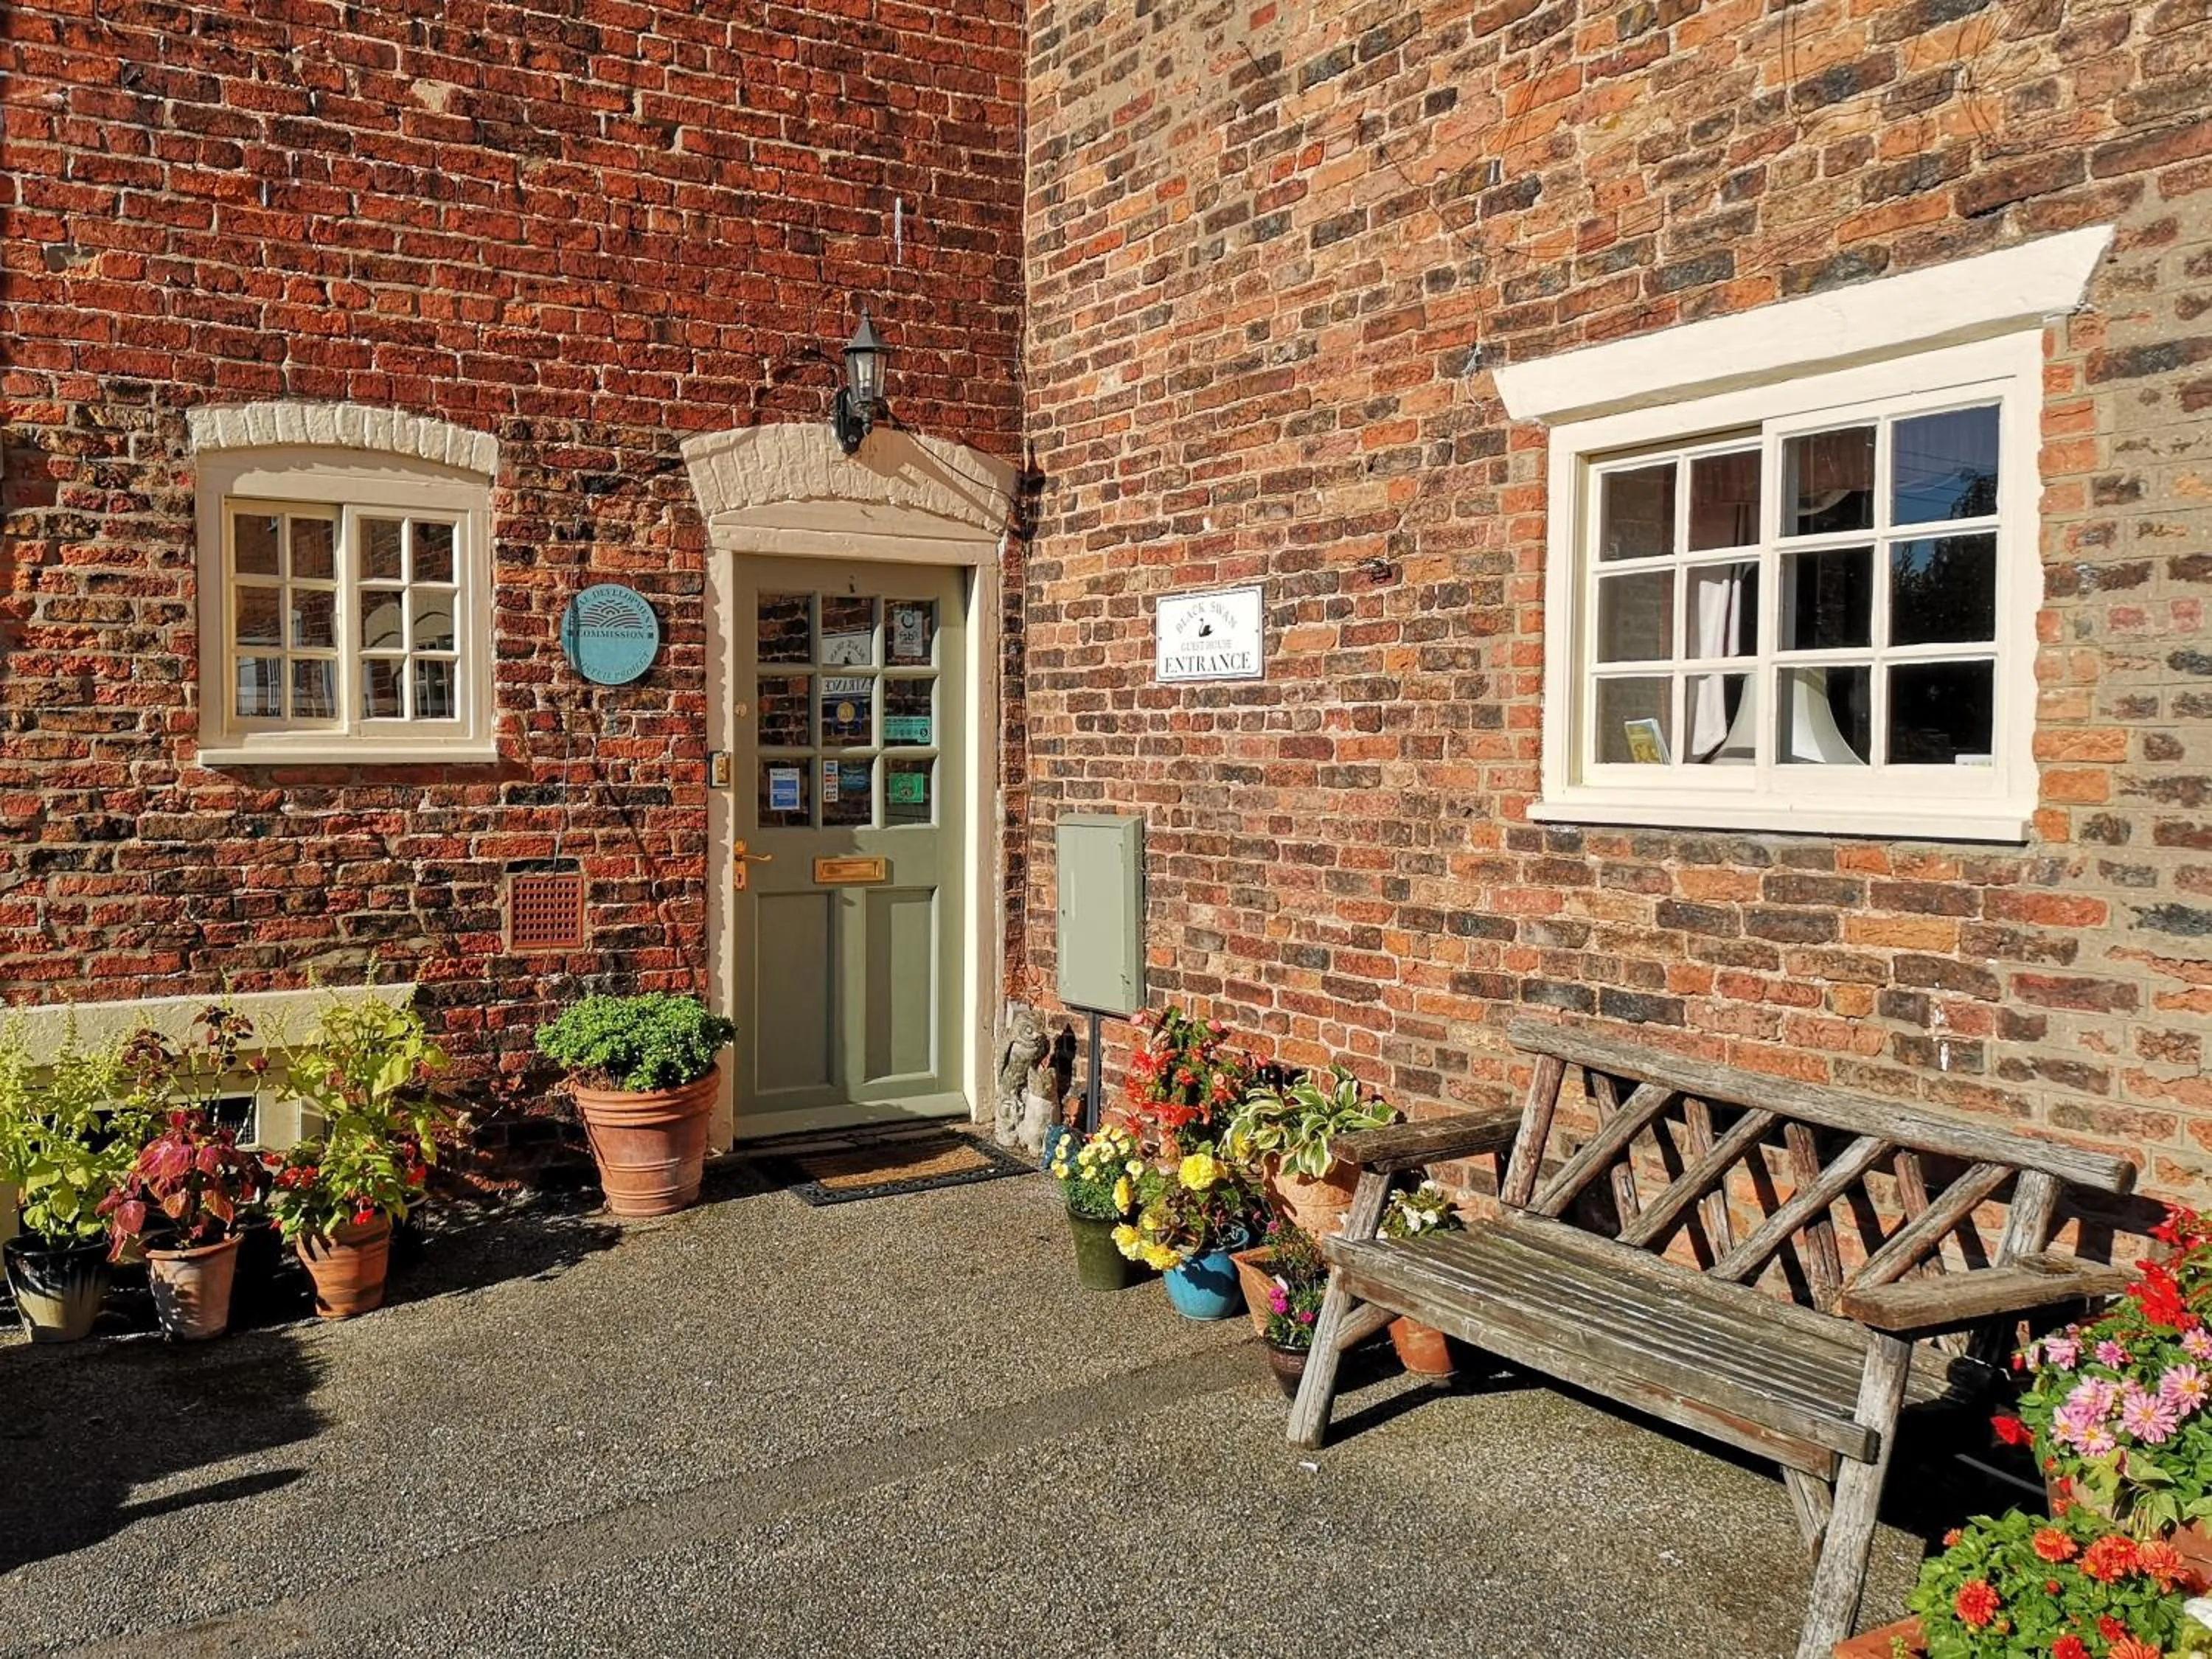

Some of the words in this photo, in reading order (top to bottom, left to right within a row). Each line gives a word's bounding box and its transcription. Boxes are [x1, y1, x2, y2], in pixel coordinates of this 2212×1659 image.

[1176, 602, 1205, 633] BLACK
[1211, 601, 1237, 629] SWAN
[575, 629, 644, 639] COMMISSION
[1164, 651, 1251, 673] ENTRANCE
